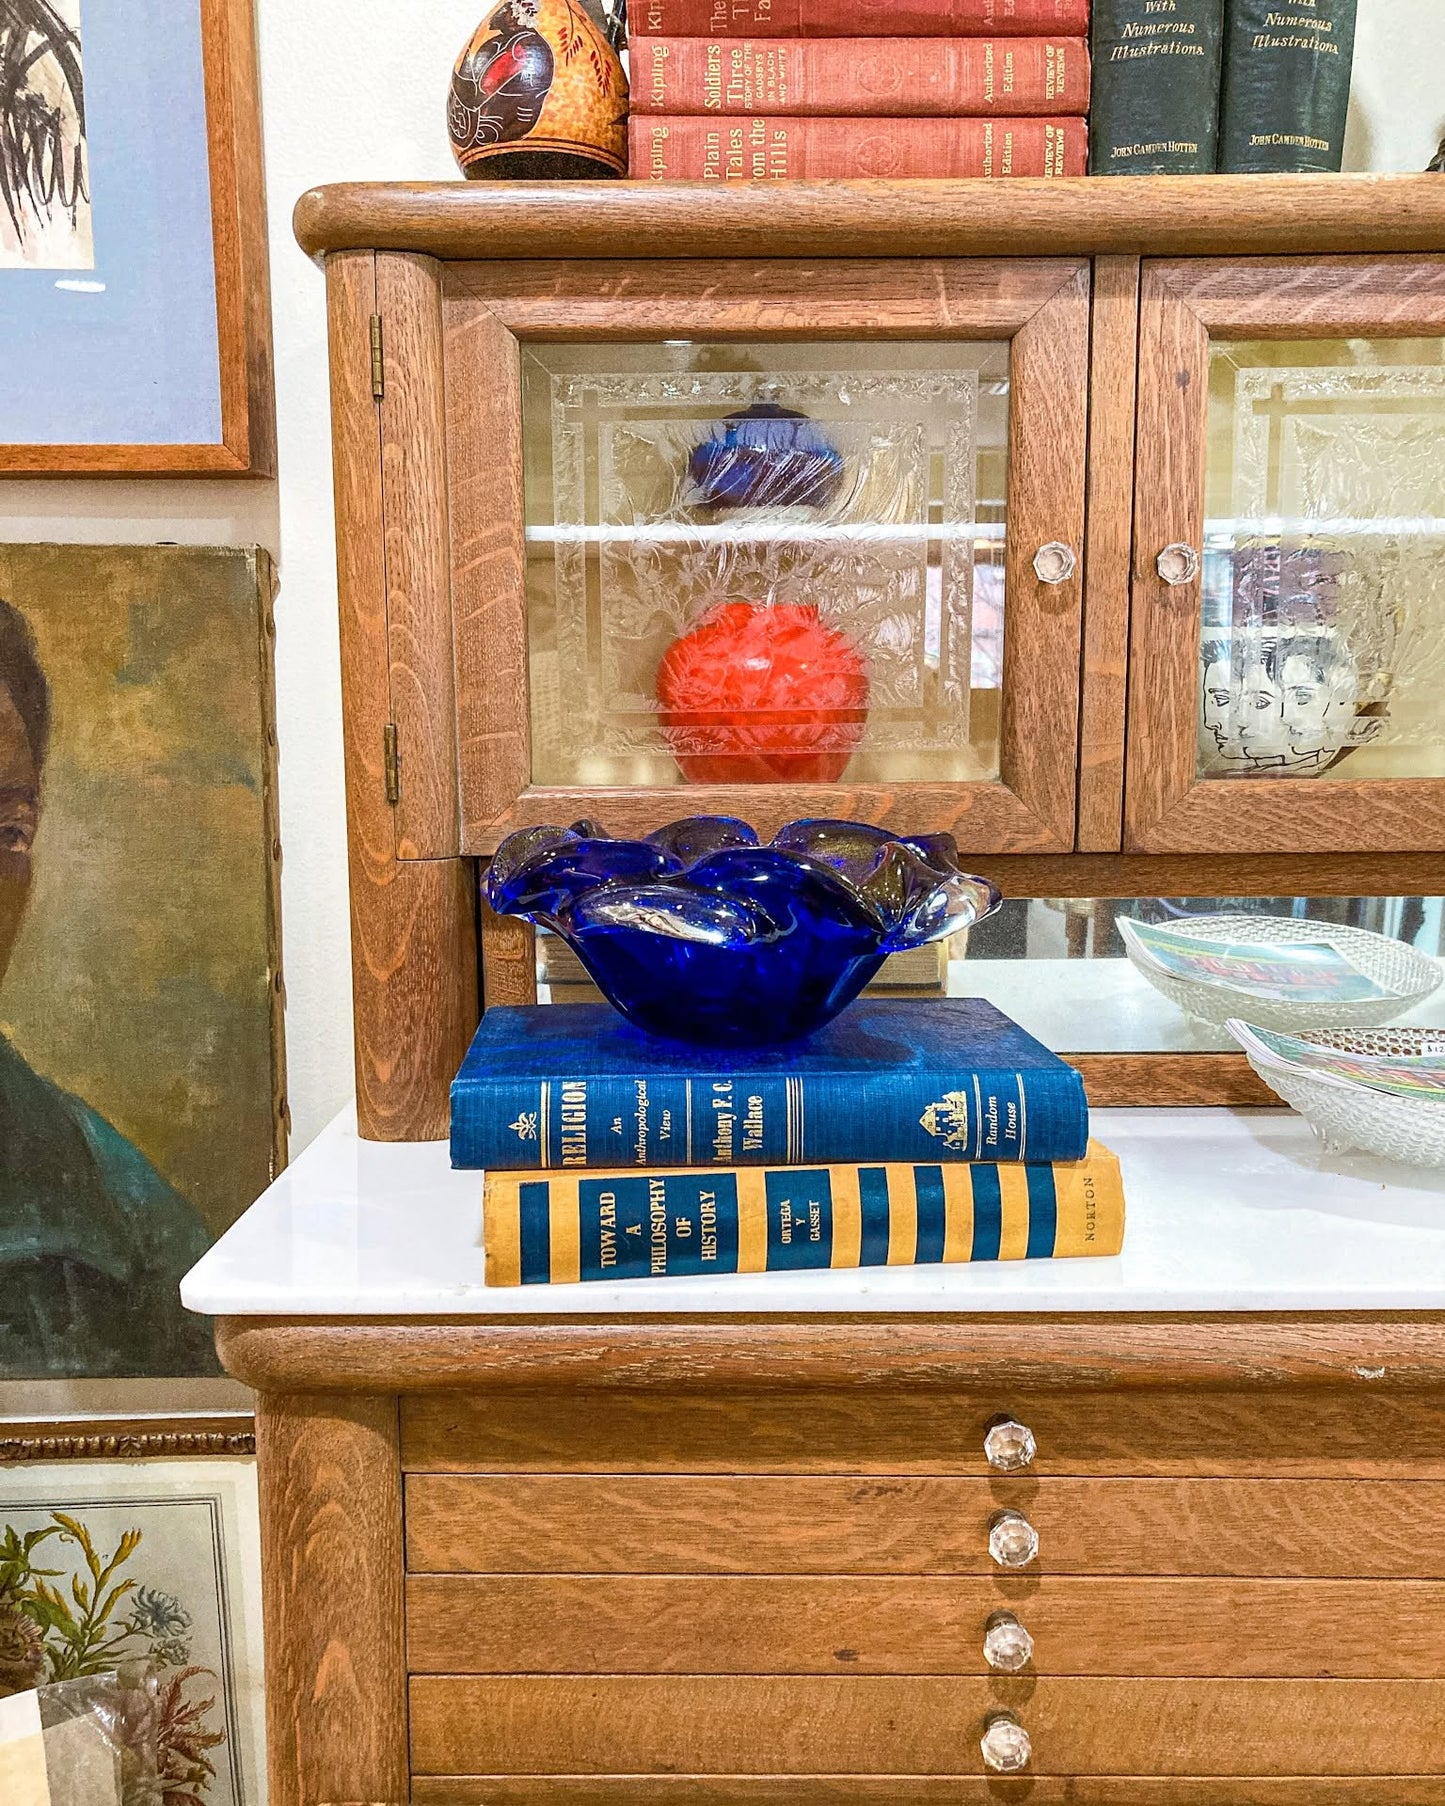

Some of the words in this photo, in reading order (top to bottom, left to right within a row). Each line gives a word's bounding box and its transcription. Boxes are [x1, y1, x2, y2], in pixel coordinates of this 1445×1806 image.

[1144, 0, 1177, 14] With
[1262, 12, 1333, 32] Numerous
[1045, 45, 1055, 57] OF
[1110, 41, 1205, 61] Illustrations.
[1121, 22, 1195, 39] Numerous
[744, 42, 752, 61] THE
[744, 63, 752, 76] OF
[767, 51, 775, 87] BLACK
[778, 47, 787, 79] WHITE
[1056, 48, 1065, 93] REVIEWS
[650, 45, 670, 107] Kipling
[704, 44, 721, 109] Soldiers
[727, 48, 743, 104] Three
[755, 53, 764, 99] GADSBYS
[983, 43, 993, 104] Authorized
[1003, 52, 1013, 93] Edition
[1045, 58, 1055, 100] REVIEW
[744, 78, 752, 109] STORY
[767, 91, 775, 102] IN
[778, 84, 787, 105] AND
[749, 119, 766, 146] the
[1045, 124, 1055, 138] OF
[1055, 128, 1065, 175] REVIEWS
[1111, 146, 1132, 158] JOHN
[1133, 143, 1167, 155] CAMDEN
[1168, 140, 1198, 153] HOTTEN
[1249, 134, 1271, 146] JOHN
[1272, 133, 1304, 146] CAMDEN
[704, 132, 720, 179] Plain
[726, 128, 743, 180] Tales
[770, 130, 787, 180] Hills
[1002, 132, 1013, 174] Edition
[562, 1081, 587, 1166] RELIGION
[611, 1117, 623, 1135] An
[634, 1079, 650, 1166] Anthropological
[659, 1109, 672, 1141] View
[712, 1112, 737, 1163] Anthony
[742, 1095, 763, 1151] Wallace
[985, 1095, 998, 1146] Random
[1004, 1101, 1017, 1140] House
[625, 1223, 642, 1236] A
[649, 1178, 667, 1275] PHILOSOPHY
[675, 1216, 692, 1239] OF
[699, 1190, 717, 1261] HISTORY
[780, 1199, 791, 1244] ORTEGA
[795, 1217, 806, 1226] Y
[808, 1199, 820, 1241] GASSET
[1083, 1176, 1095, 1242] NORTON
[599, 1192, 617, 1269] TOWARD
